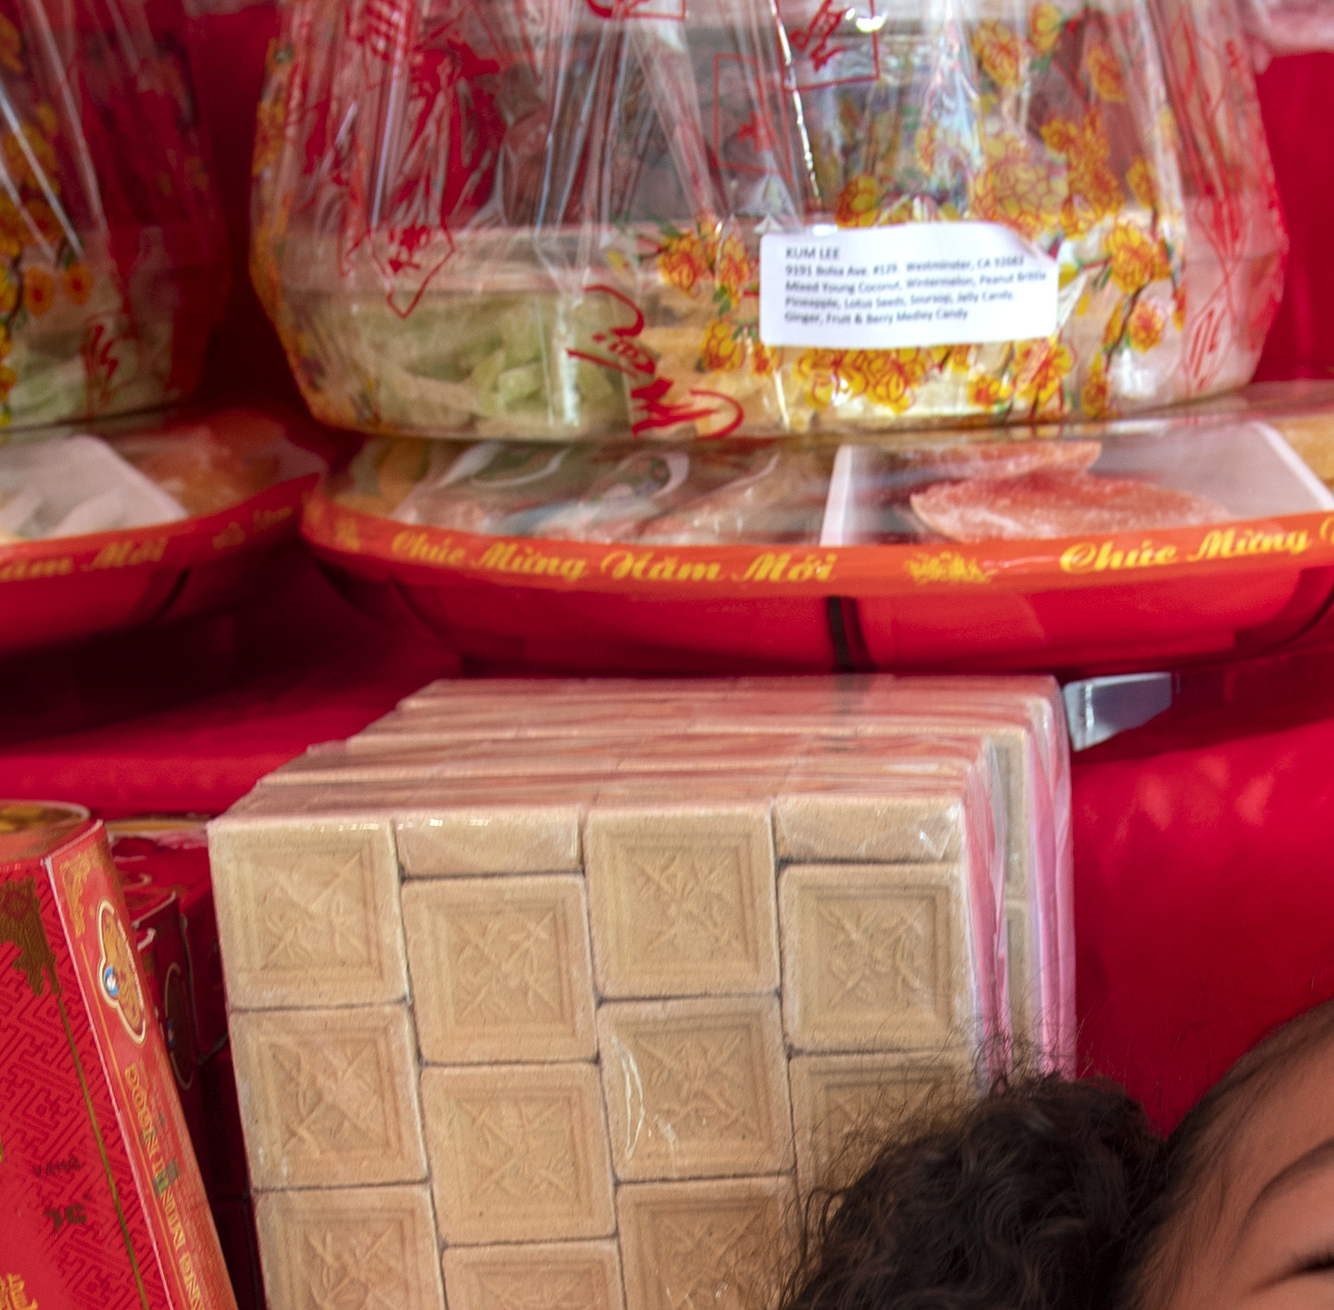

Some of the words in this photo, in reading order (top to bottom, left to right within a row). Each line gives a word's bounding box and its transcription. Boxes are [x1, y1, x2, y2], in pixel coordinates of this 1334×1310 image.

[785, 247, 816, 259] KUM
[819, 247, 840, 259] LEE
[822, 281, 855, 294] Young
[391, 530, 466, 565] Chúc
[599, 548, 724, 583] Năm
[731, 552, 838, 584] Mới
[1059, 538, 1178, 575] Chúc
